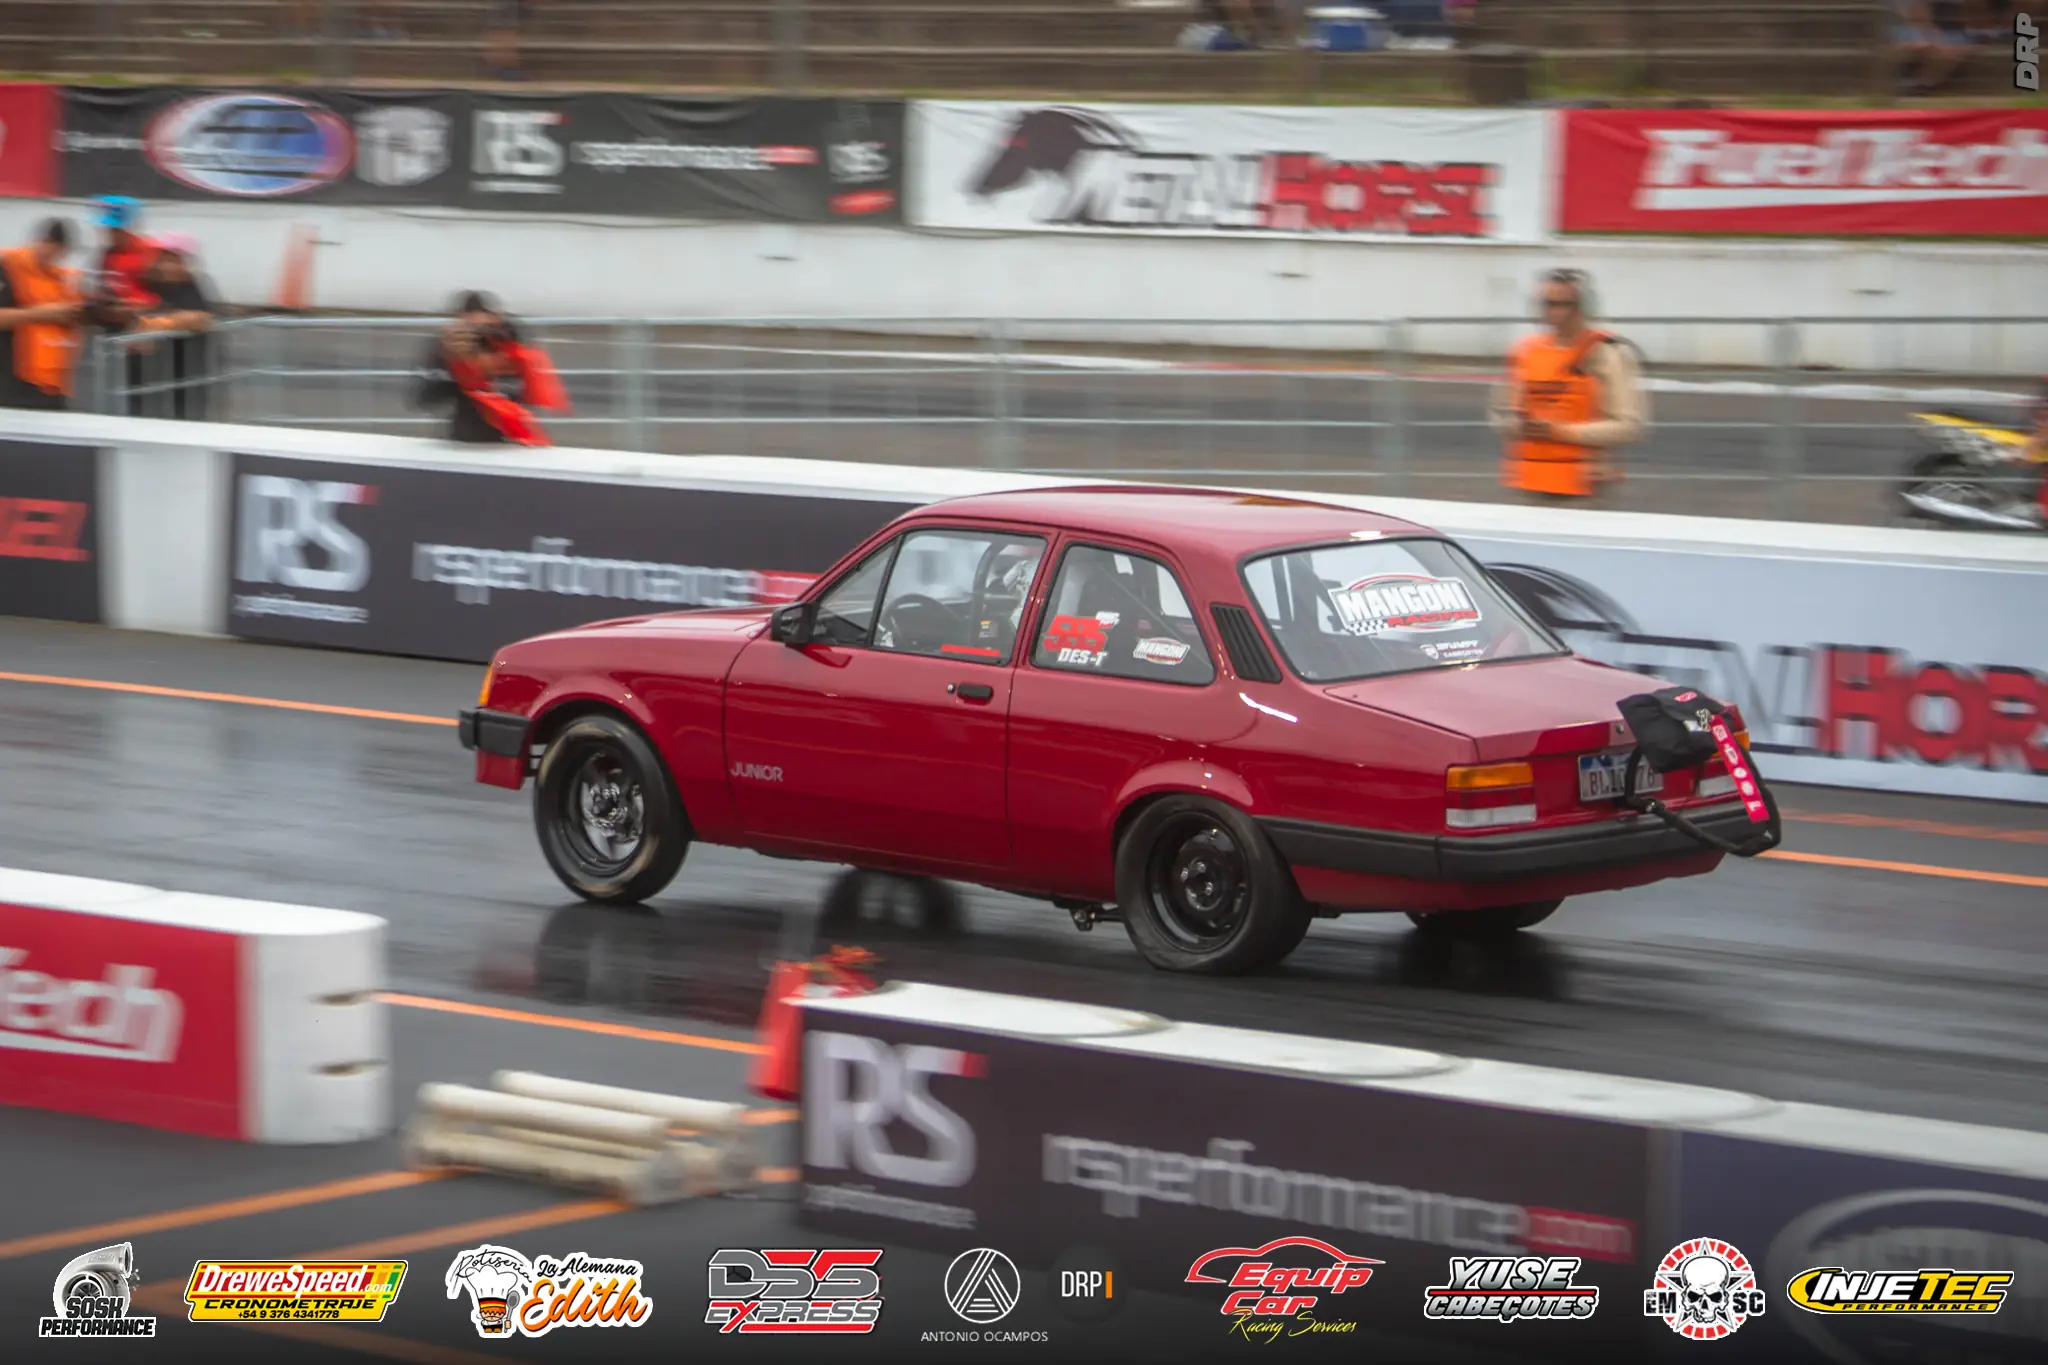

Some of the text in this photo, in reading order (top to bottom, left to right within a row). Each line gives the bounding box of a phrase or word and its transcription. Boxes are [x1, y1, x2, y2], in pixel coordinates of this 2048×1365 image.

[235, 474, 380, 592] RS
[1337, 583, 1471, 622] MANGONI
[730, 761, 784, 782] JUNIOR
[803, 1030, 989, 1187] RS
